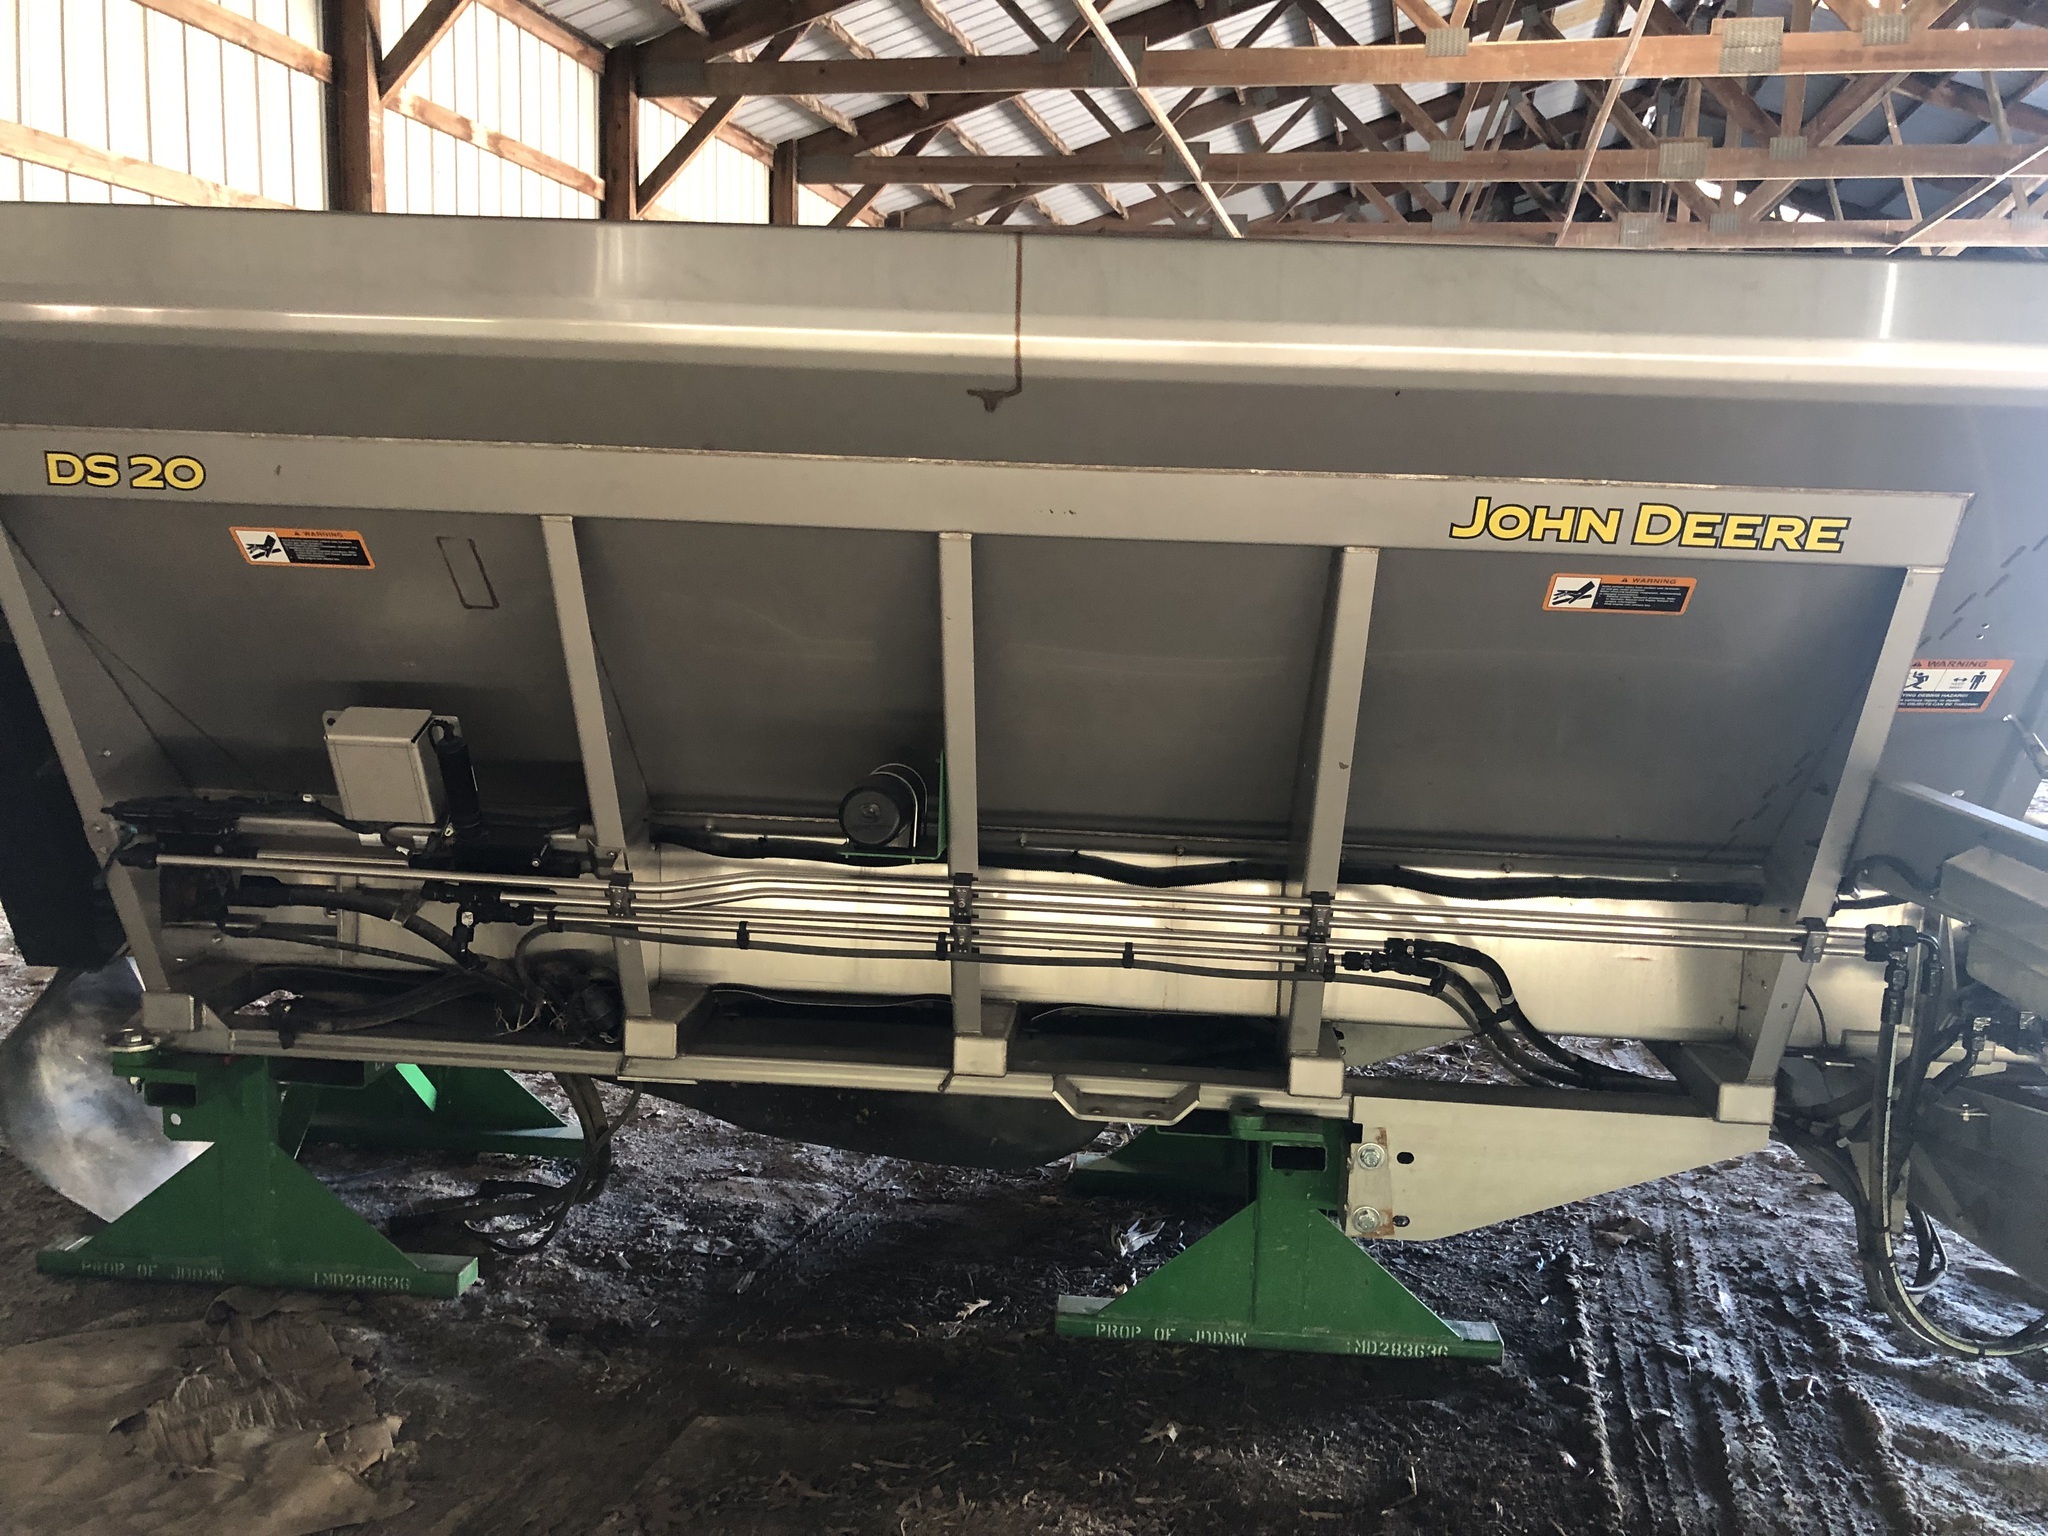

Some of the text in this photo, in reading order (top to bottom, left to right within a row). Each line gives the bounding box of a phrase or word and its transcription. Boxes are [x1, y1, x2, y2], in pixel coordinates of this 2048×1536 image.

[44, 451, 206, 491] DS 20
[1449, 496, 1852, 554] JOHN DEERE
[137, 1263, 158, 1277] OF
[1096, 1323, 1142, 1338] PROP
[1154, 1327, 1176, 1341] OF
